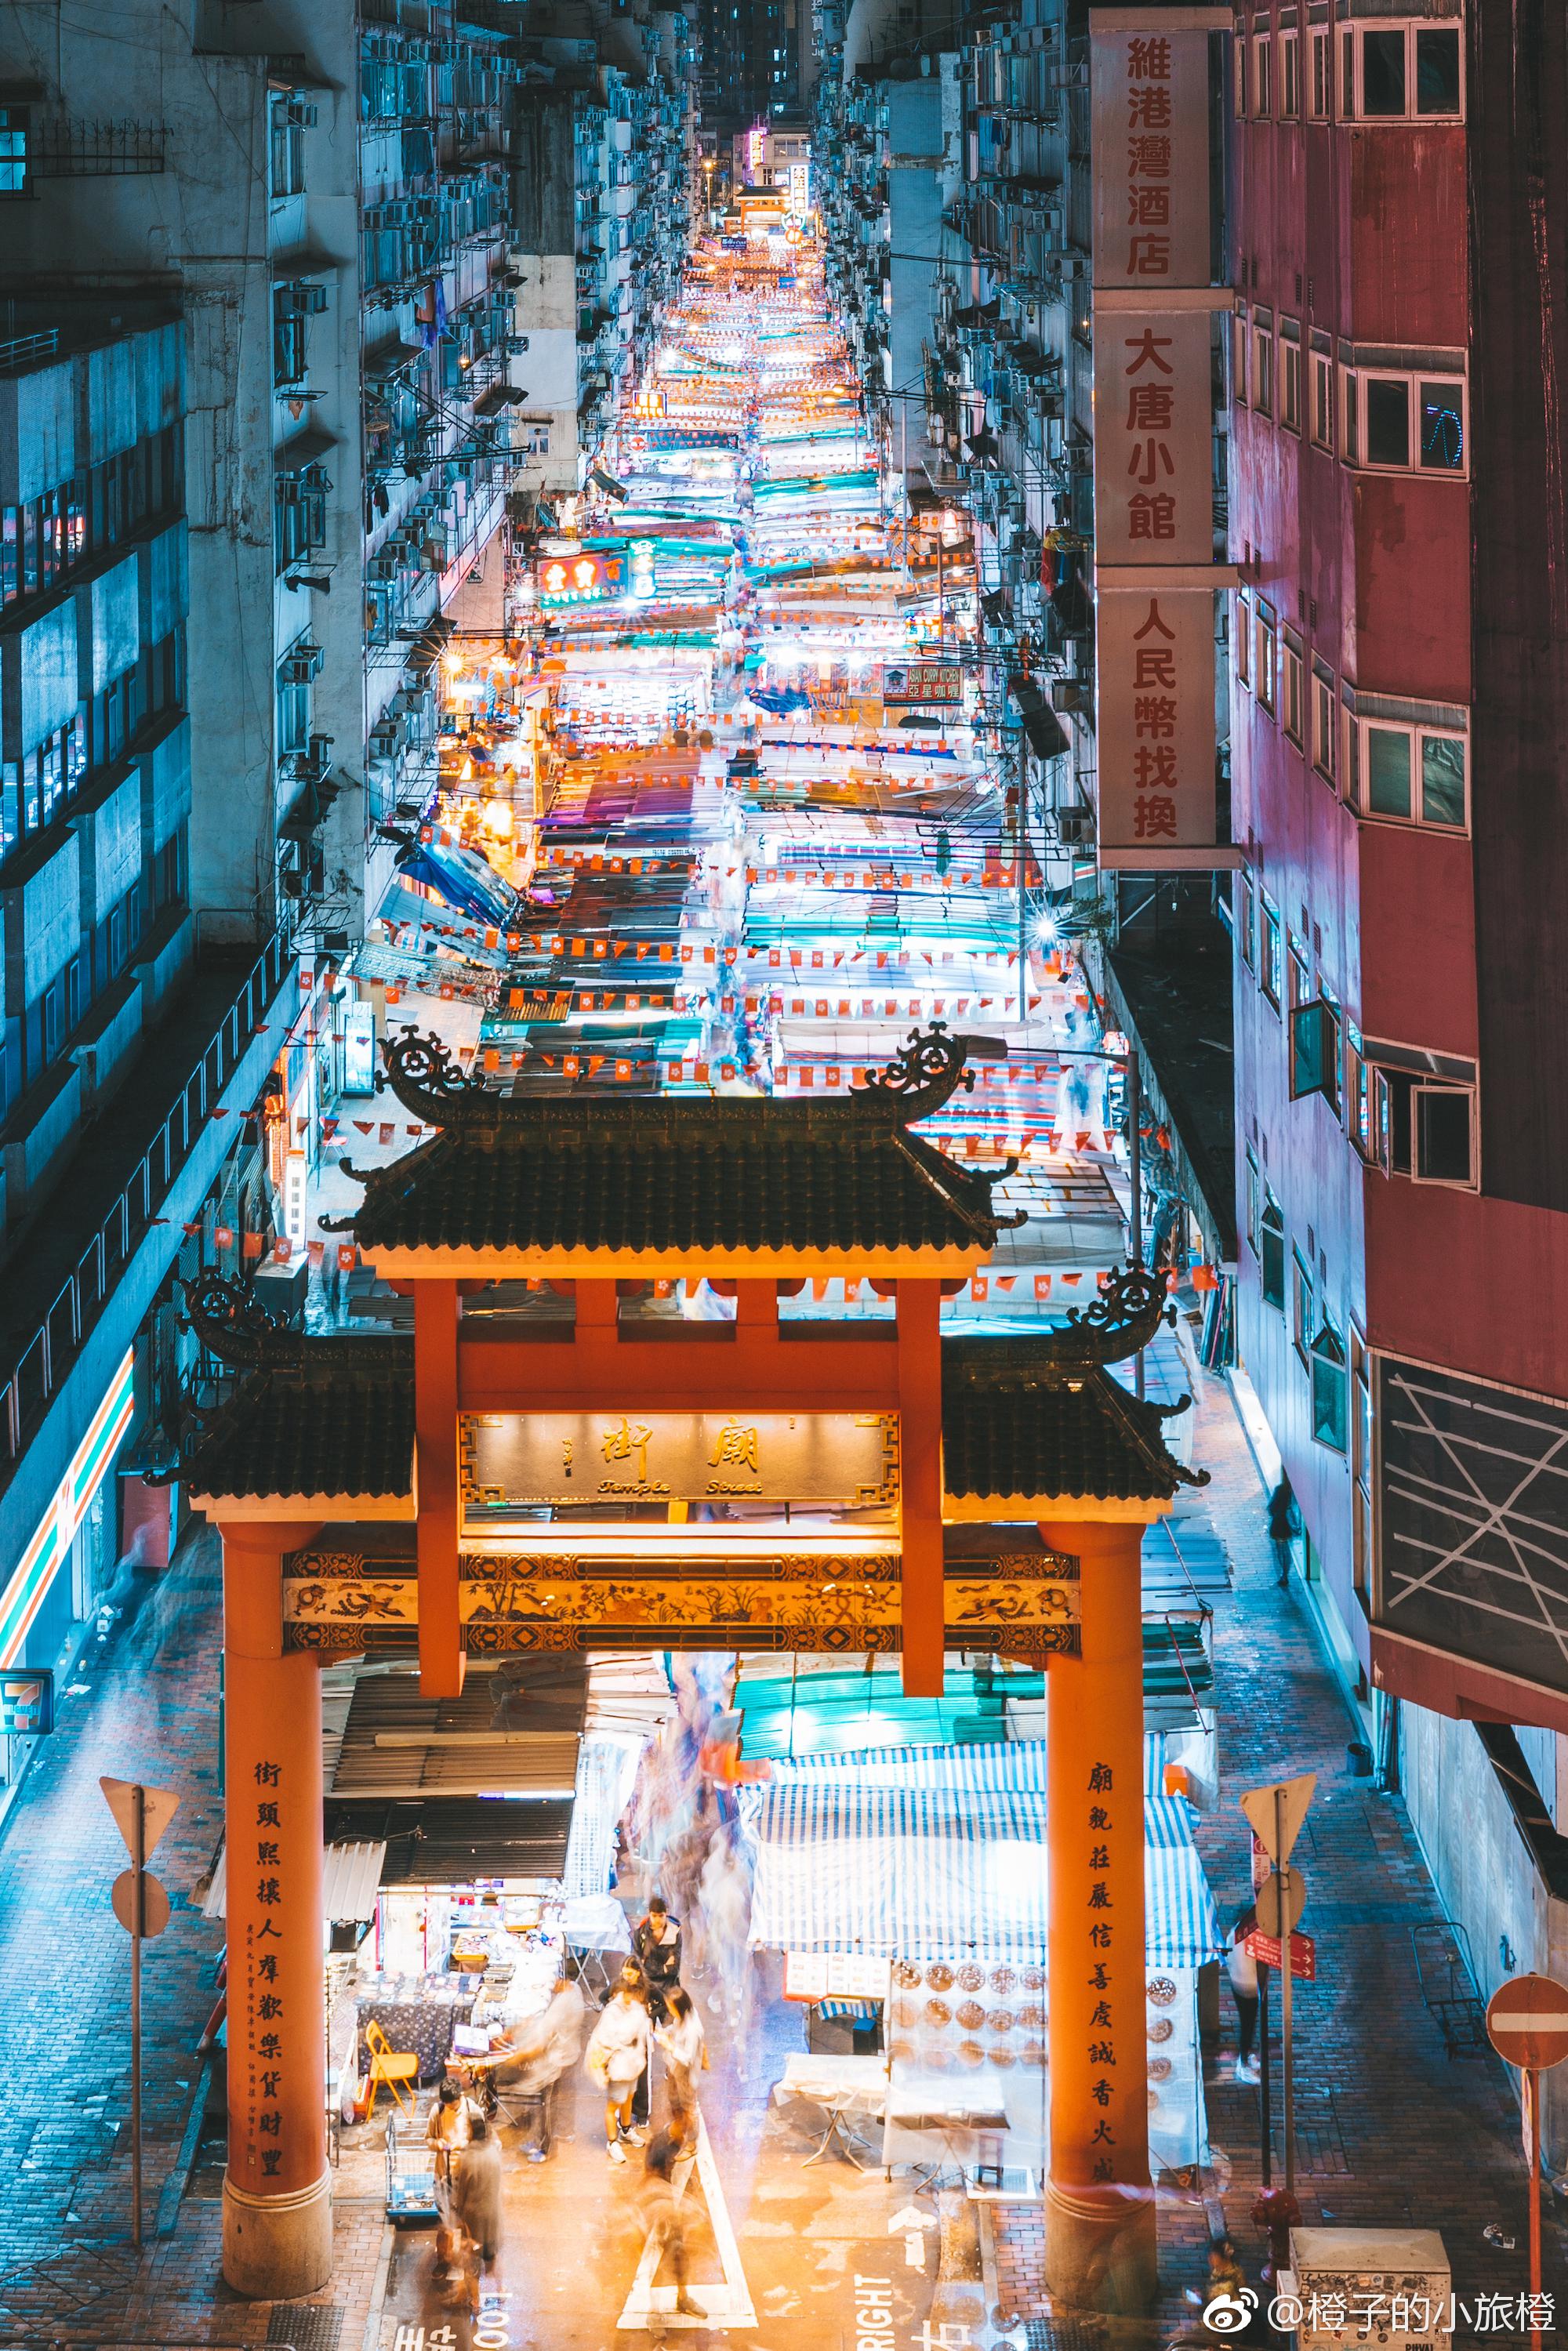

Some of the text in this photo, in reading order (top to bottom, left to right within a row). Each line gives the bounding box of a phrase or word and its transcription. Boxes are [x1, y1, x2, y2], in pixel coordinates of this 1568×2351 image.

[1127, 38, 1172, 276] 維港灣酒店
[1125, 328, 1176, 540] 大唐小館
[909, 669, 959, 683] ASIAN CURRY KITCHEN
[1133, 598, 1178, 839] 人民幣找換
[597, 1479, 764, 1496] Temple Street
[472, 2292, 514, 2351] LOO
[854, 2274, 895, 2351] RIGHT
